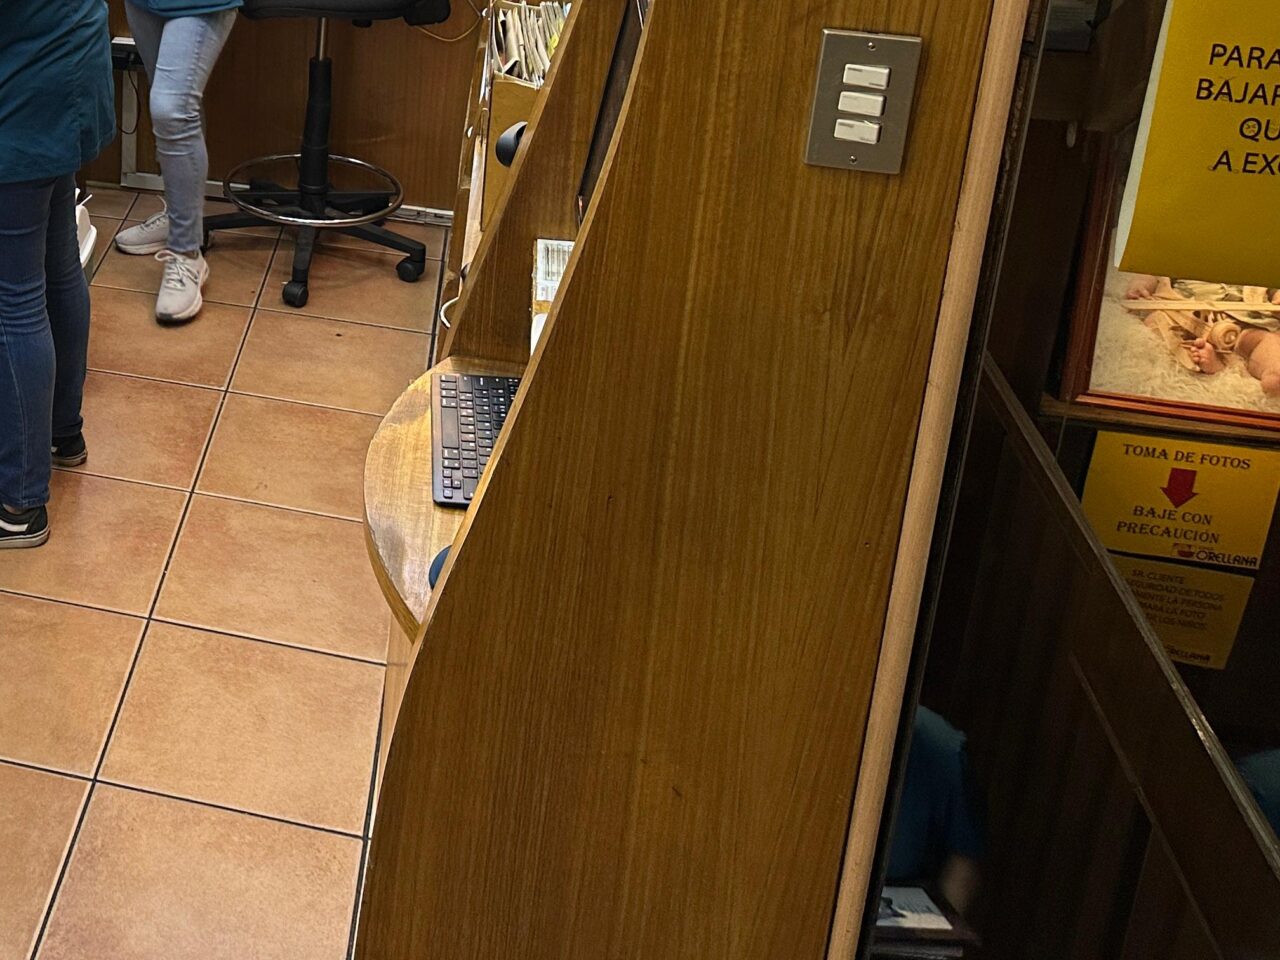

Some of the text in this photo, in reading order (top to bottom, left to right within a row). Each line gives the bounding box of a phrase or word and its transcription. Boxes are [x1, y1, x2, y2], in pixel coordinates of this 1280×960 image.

[1123, 443, 1251, 470] TOMA DE FOTOS
[1132, 505, 1213, 526] BAJE CON
[1116, 520, 1221, 545] PRECAUCIÓN
[1195, 550, 1259, 568] ORELLANA
